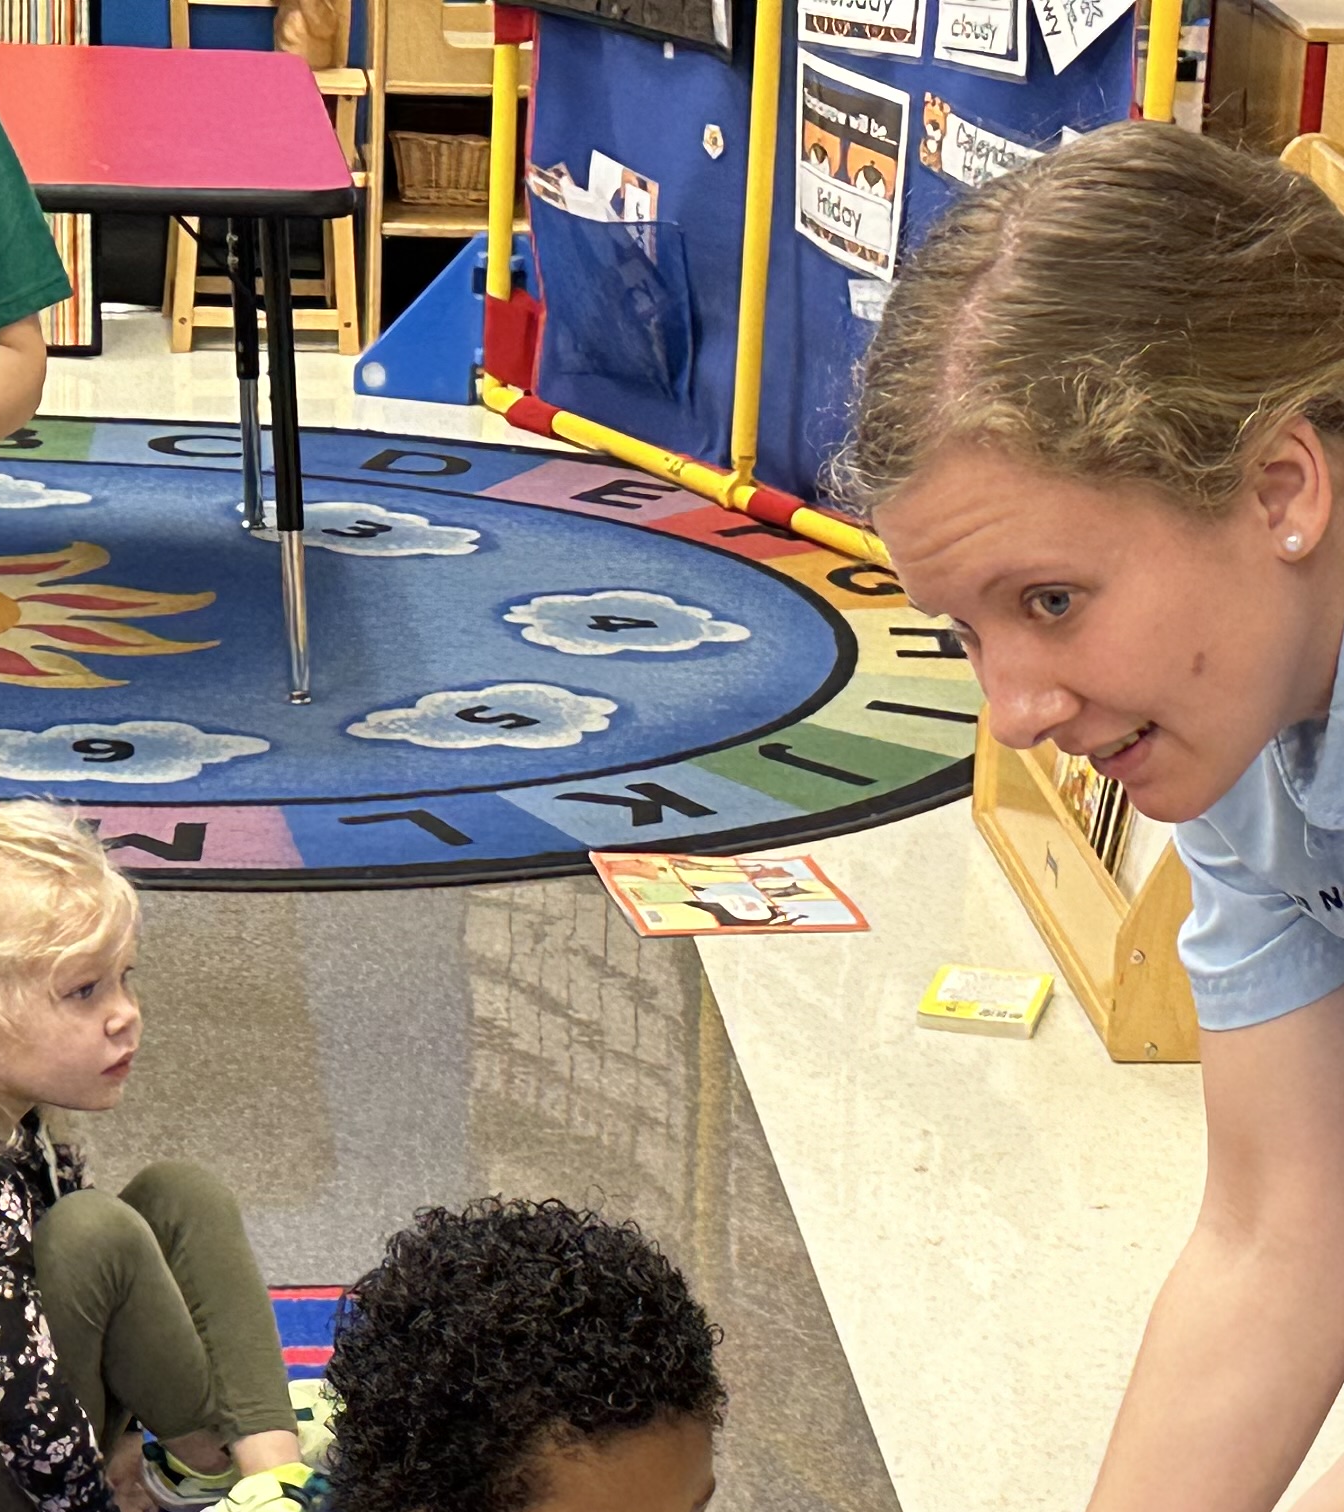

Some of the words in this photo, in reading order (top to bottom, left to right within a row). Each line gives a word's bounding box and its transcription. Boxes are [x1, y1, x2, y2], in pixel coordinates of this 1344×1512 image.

[816, 186, 862, 238] Friday
[360, 449, 473, 477] D
[570, 479, 668, 509] E
[587, 614, 660, 633] 4
[455, 704, 542, 730] 5
[758, 742, 879, 787] J
[556, 782, 719, 826] K
[338, 808, 474, 846] L
